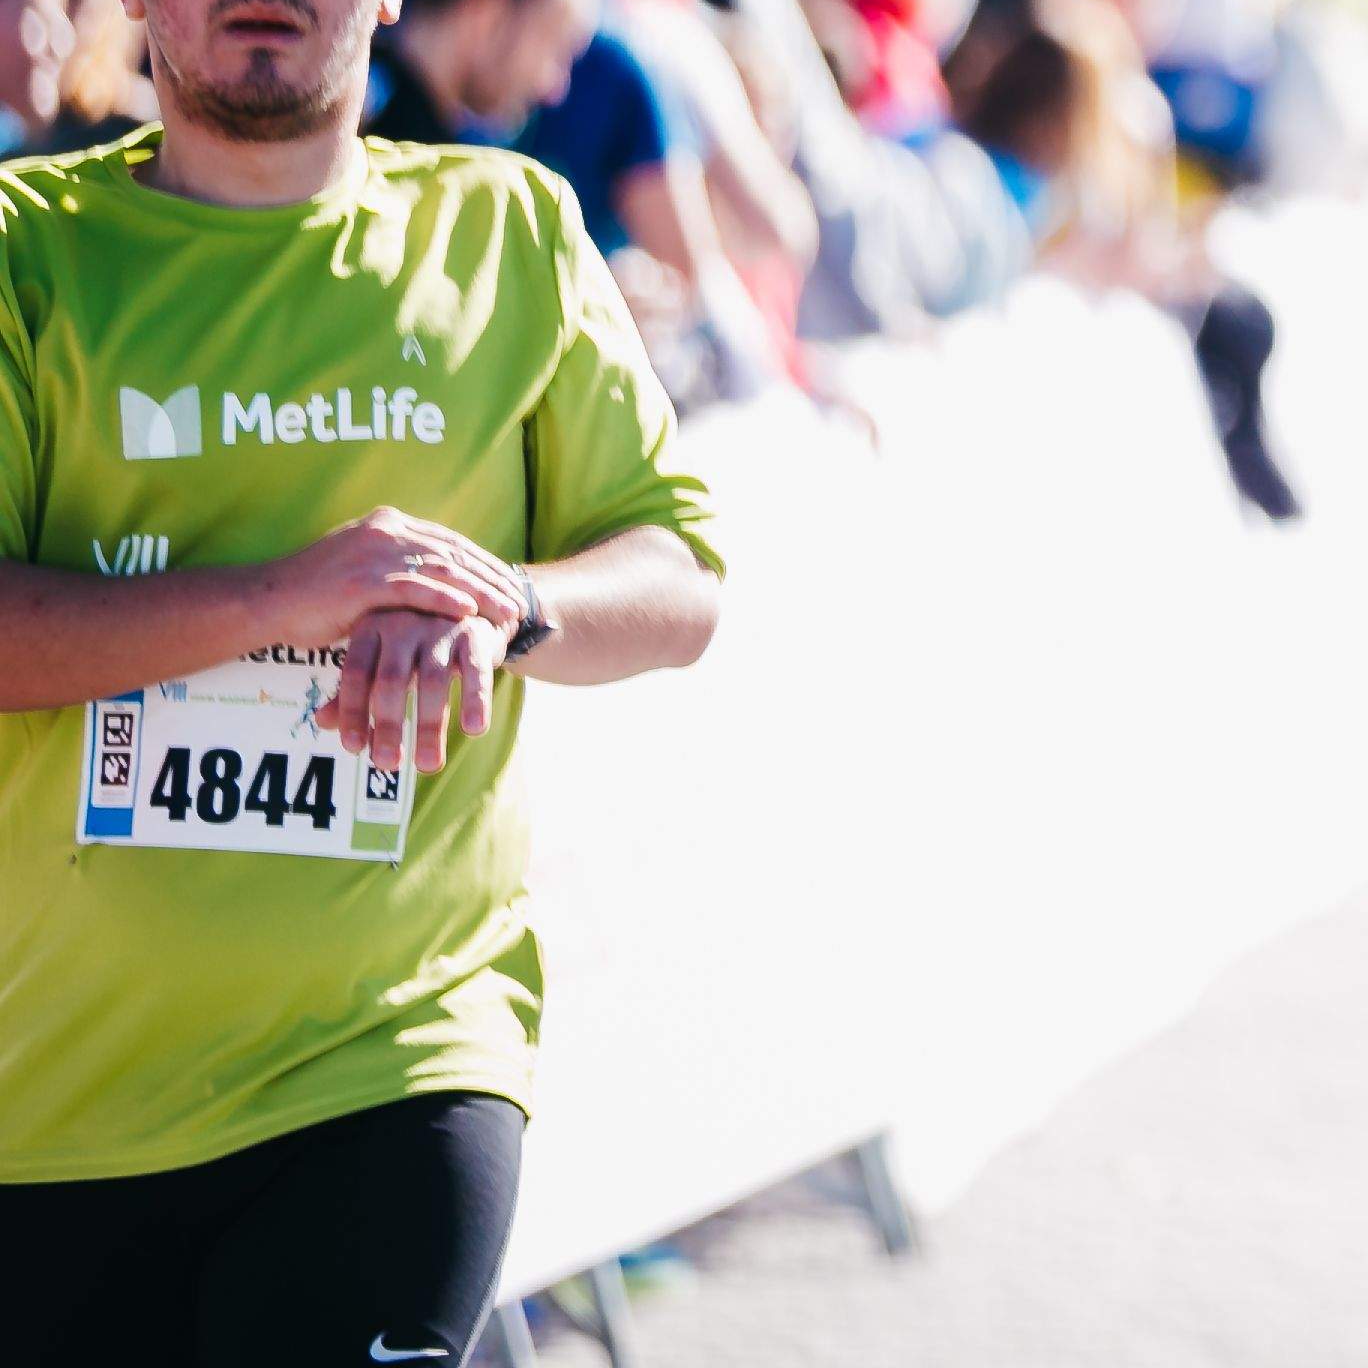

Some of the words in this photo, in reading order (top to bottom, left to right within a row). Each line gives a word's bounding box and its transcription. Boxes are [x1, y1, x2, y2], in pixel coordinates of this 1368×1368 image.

[221, 386, 447, 445] MetLife
[92, 533, 169, 576] VIII
[240, 642, 348, 668] etLife
[150, 747, 337, 830] 4844
